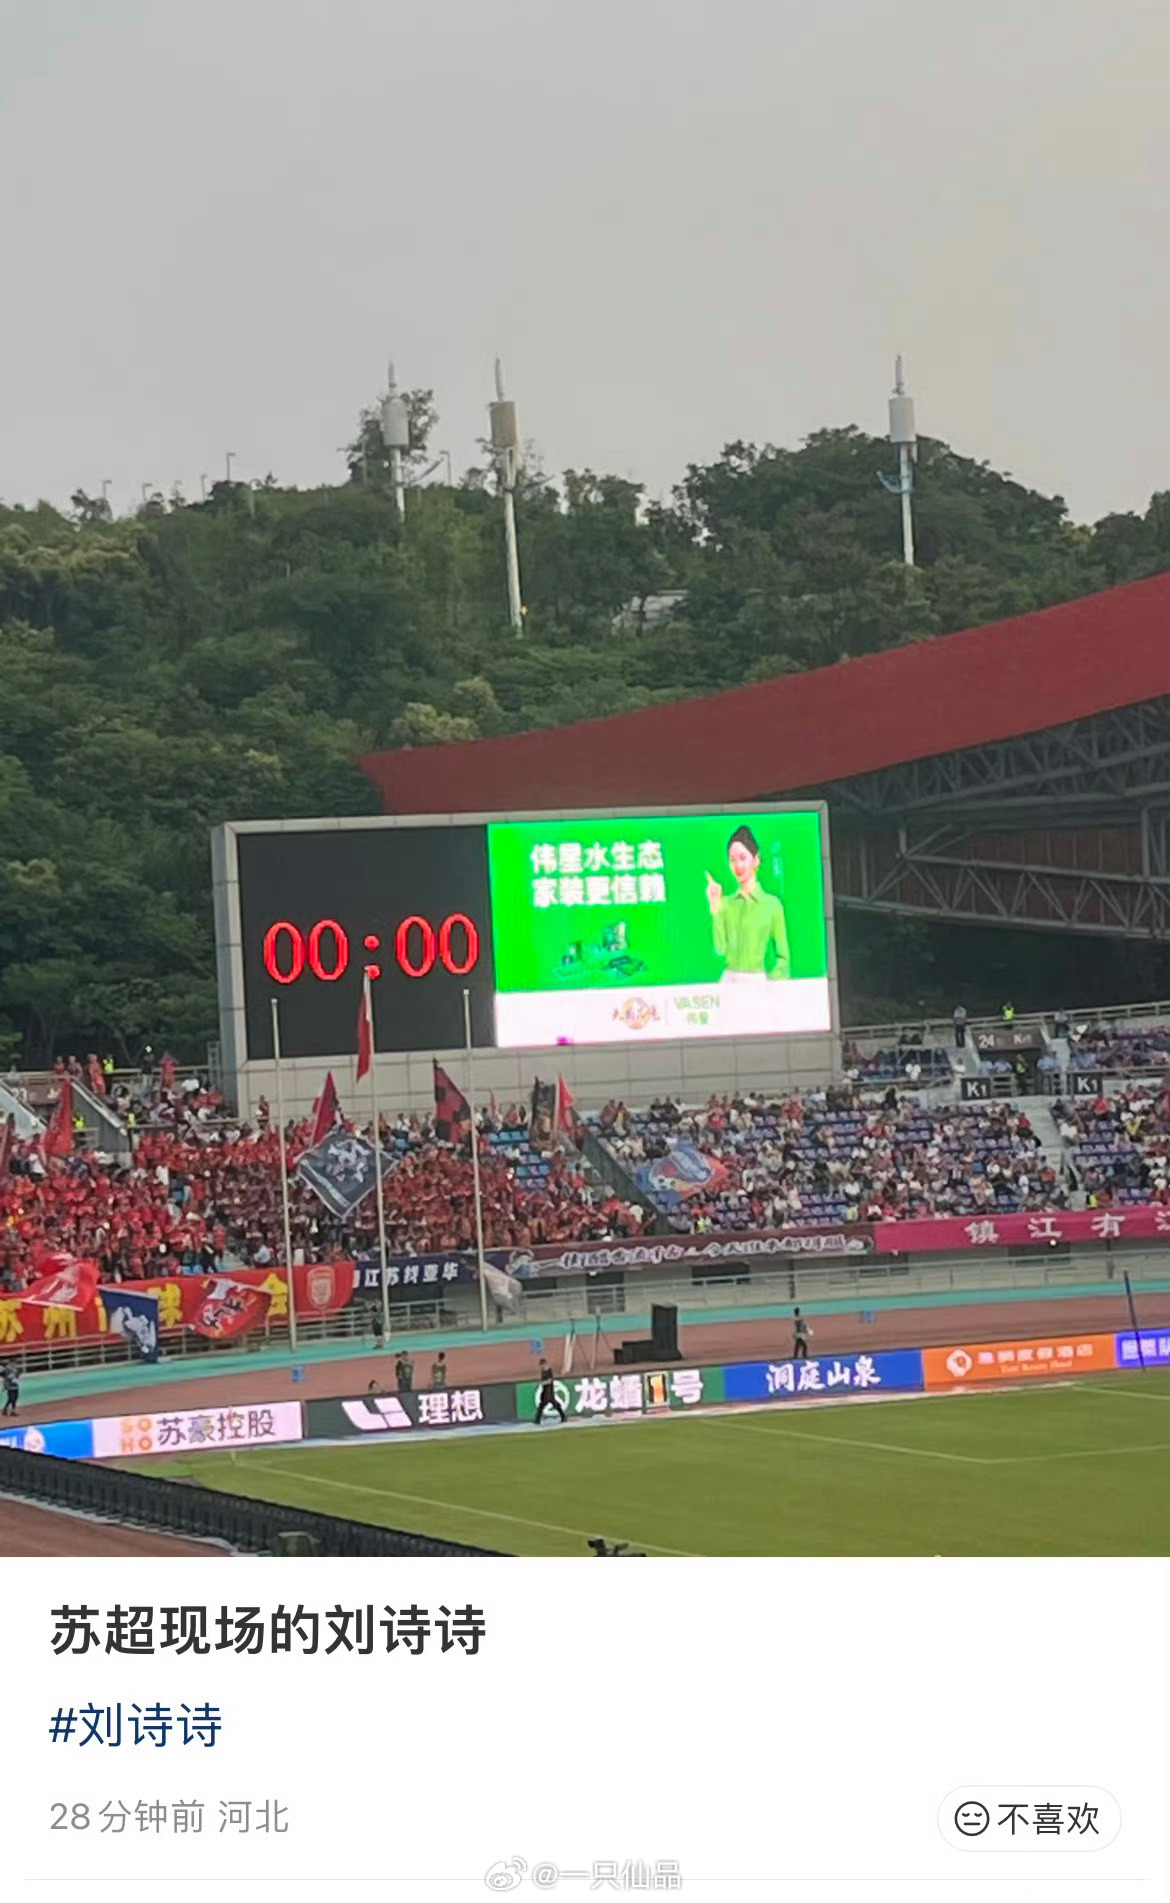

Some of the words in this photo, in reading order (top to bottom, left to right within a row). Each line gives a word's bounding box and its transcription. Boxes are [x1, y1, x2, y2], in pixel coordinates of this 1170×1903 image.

[530, 839, 665, 874] 伟星水生态
[264, 914, 480, 984] 00:00
[966, 1081, 987, 1097] K1
[1077, 1076, 1098, 1091] K1
[765, 1355, 882, 1394] 洞庭山泉
[417, 1390, 484, 1424] 理想
[157, 1409, 275, 1446] 苏豪控股
